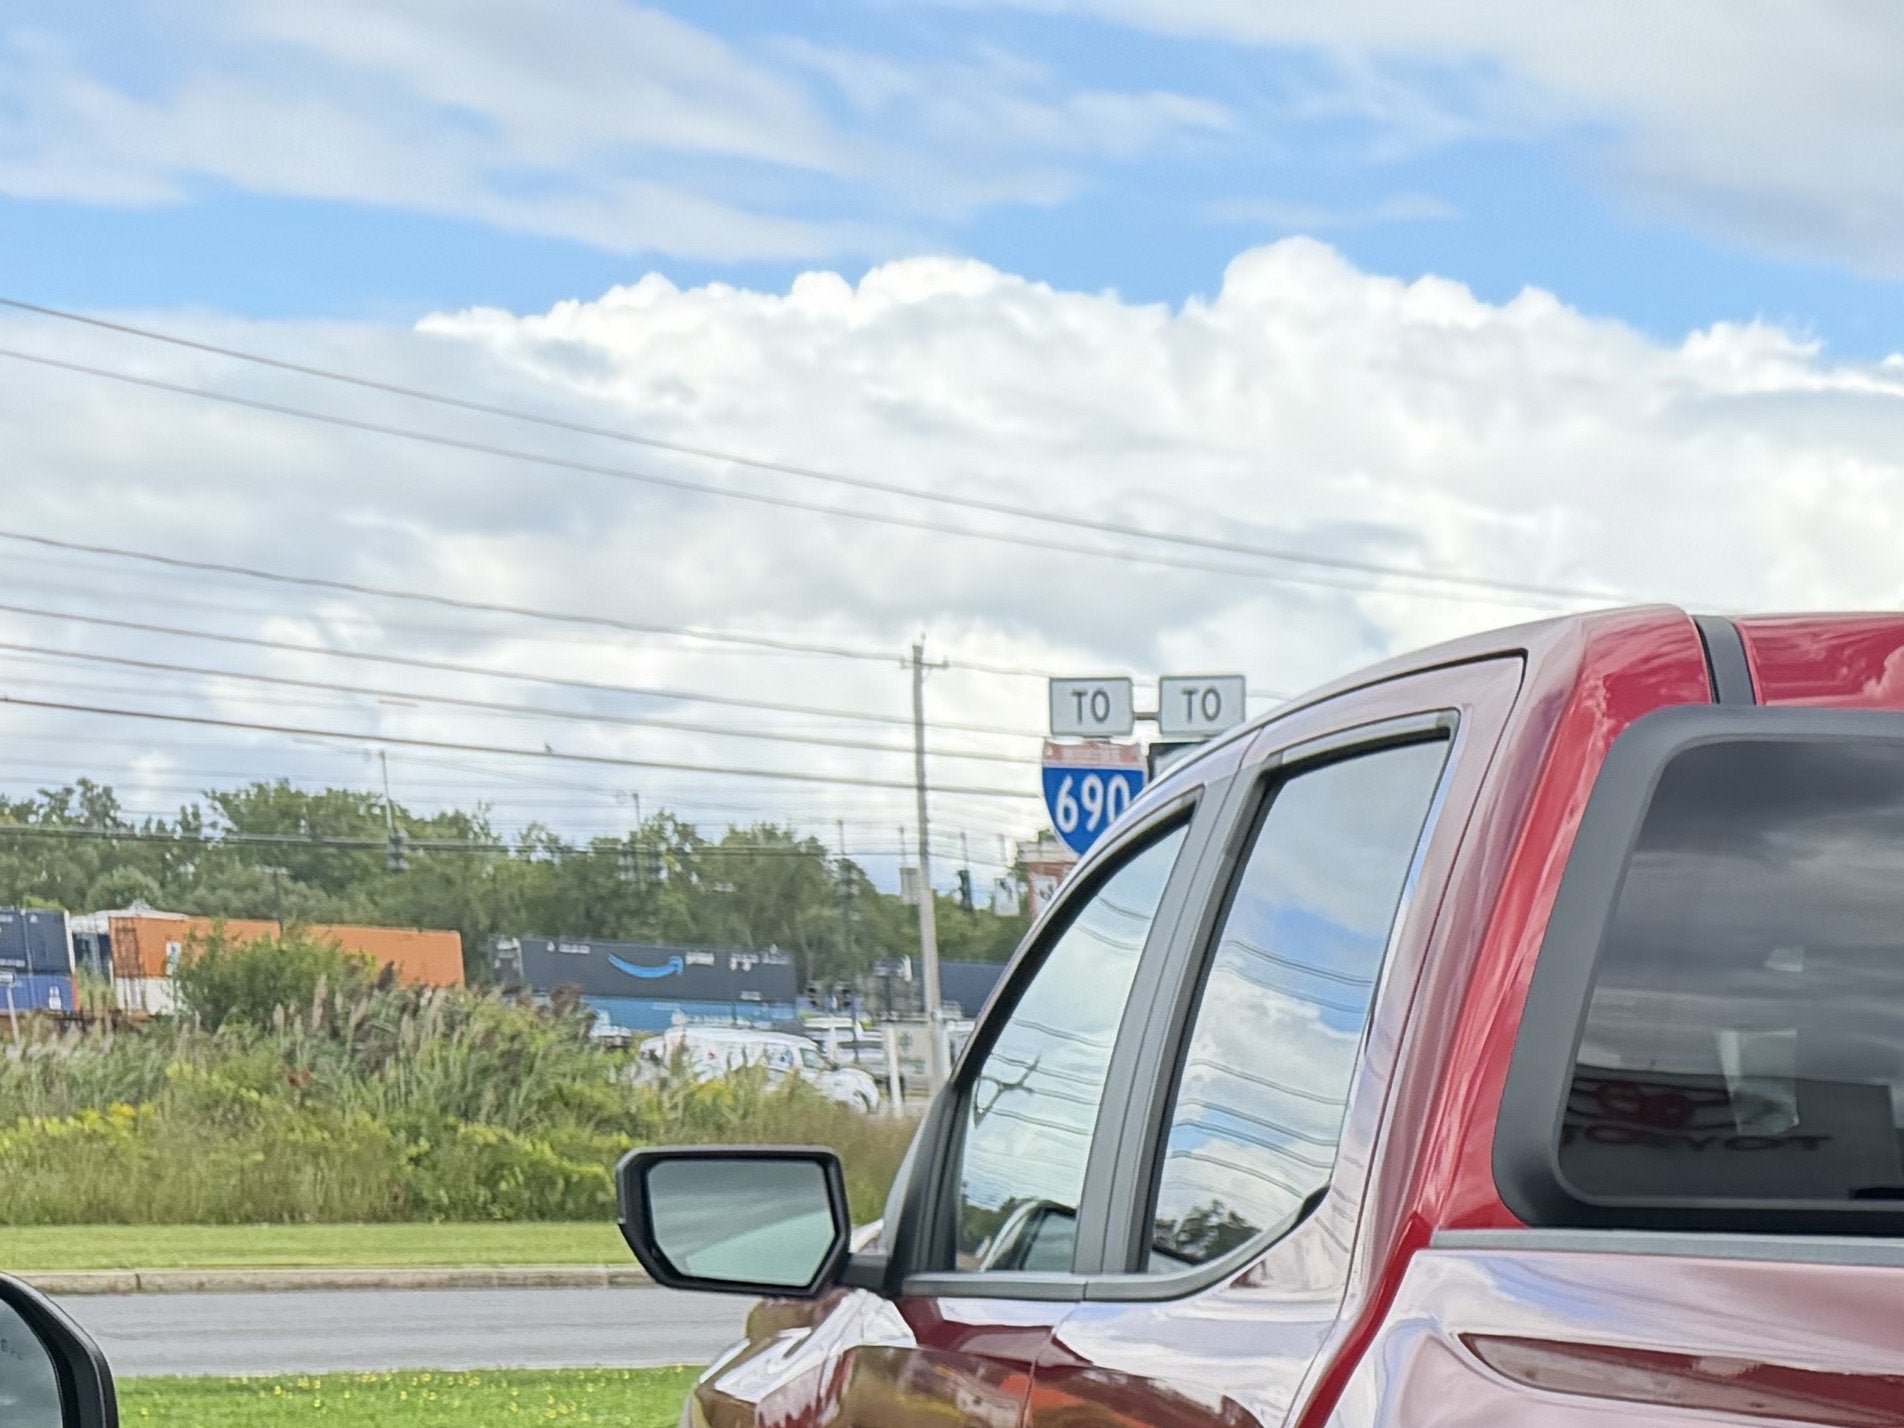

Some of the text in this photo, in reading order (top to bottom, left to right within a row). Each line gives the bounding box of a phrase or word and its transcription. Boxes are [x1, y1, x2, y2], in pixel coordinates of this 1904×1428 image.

[1071, 686, 1111, 726] TO
[1181, 684, 1221, 724] TO
[1055, 773, 1131, 834] 690
